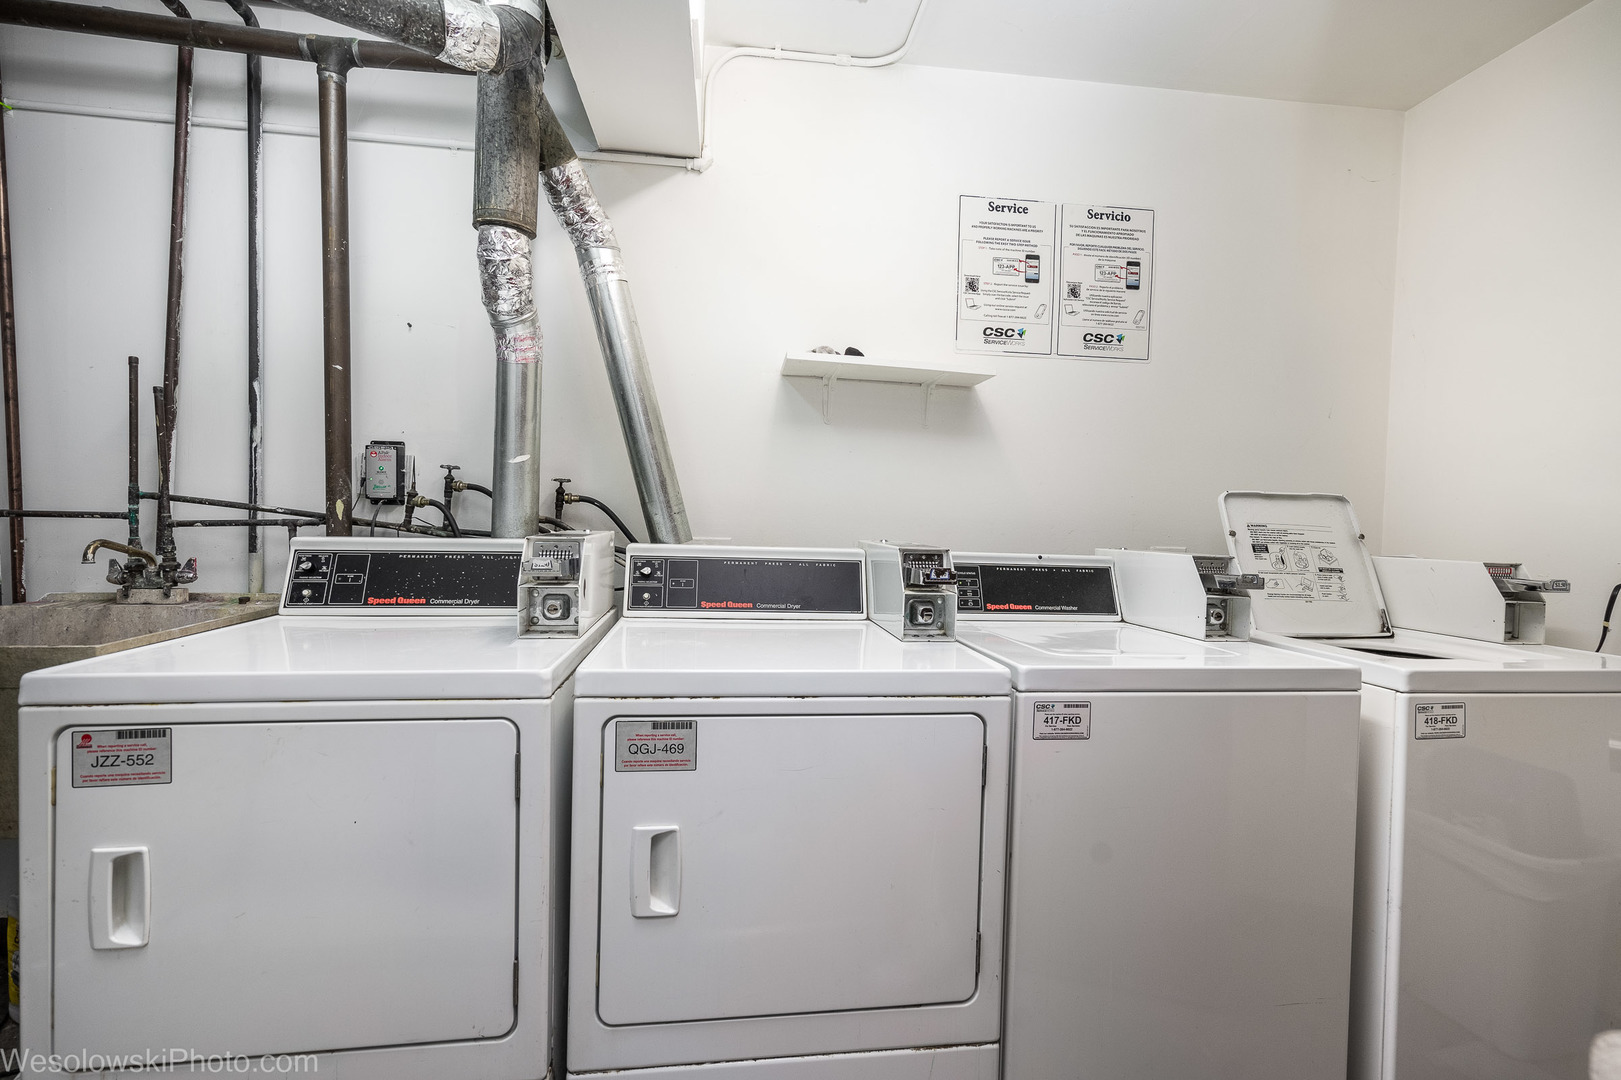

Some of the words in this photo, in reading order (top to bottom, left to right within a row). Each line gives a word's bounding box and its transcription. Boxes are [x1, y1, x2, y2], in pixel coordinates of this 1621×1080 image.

[988, 201, 1028, 214] Service
[1087, 209, 1131, 222] Servicio
[983, 327, 1015, 337] CSC
[1083, 333, 1114, 343] CSC
[368, 597, 396, 605] Speed
[1424, 716, 1457, 724] 418-FKD
[628, 744, 684, 755] QGJ-469
[91, 754, 154, 768] JZZ-552
